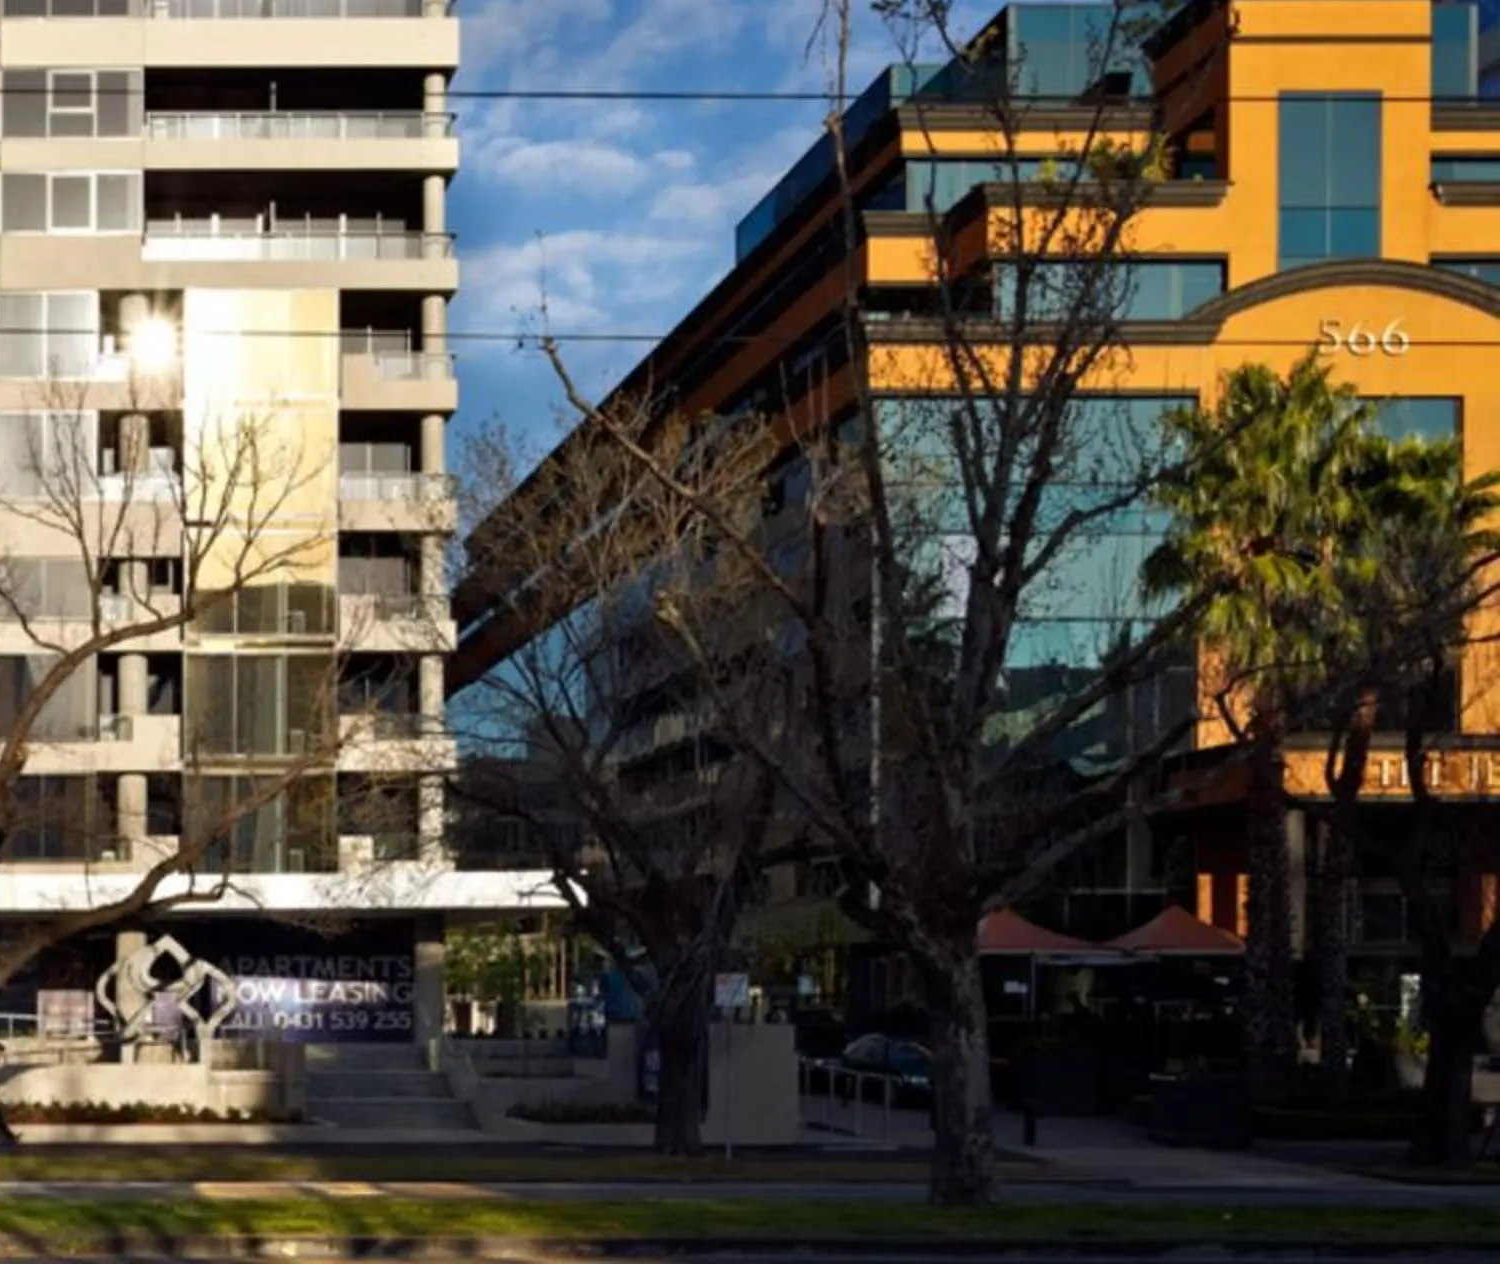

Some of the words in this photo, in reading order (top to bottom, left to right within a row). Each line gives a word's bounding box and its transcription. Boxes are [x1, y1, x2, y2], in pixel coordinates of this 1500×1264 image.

[1318, 318, 1410, 356] 566
[218, 954, 412, 979] APARTMENTS
[294, 980, 414, 1004] LEASING
[329, 1010, 369, 1030] 539
[373, 1010, 412, 1030] 255
